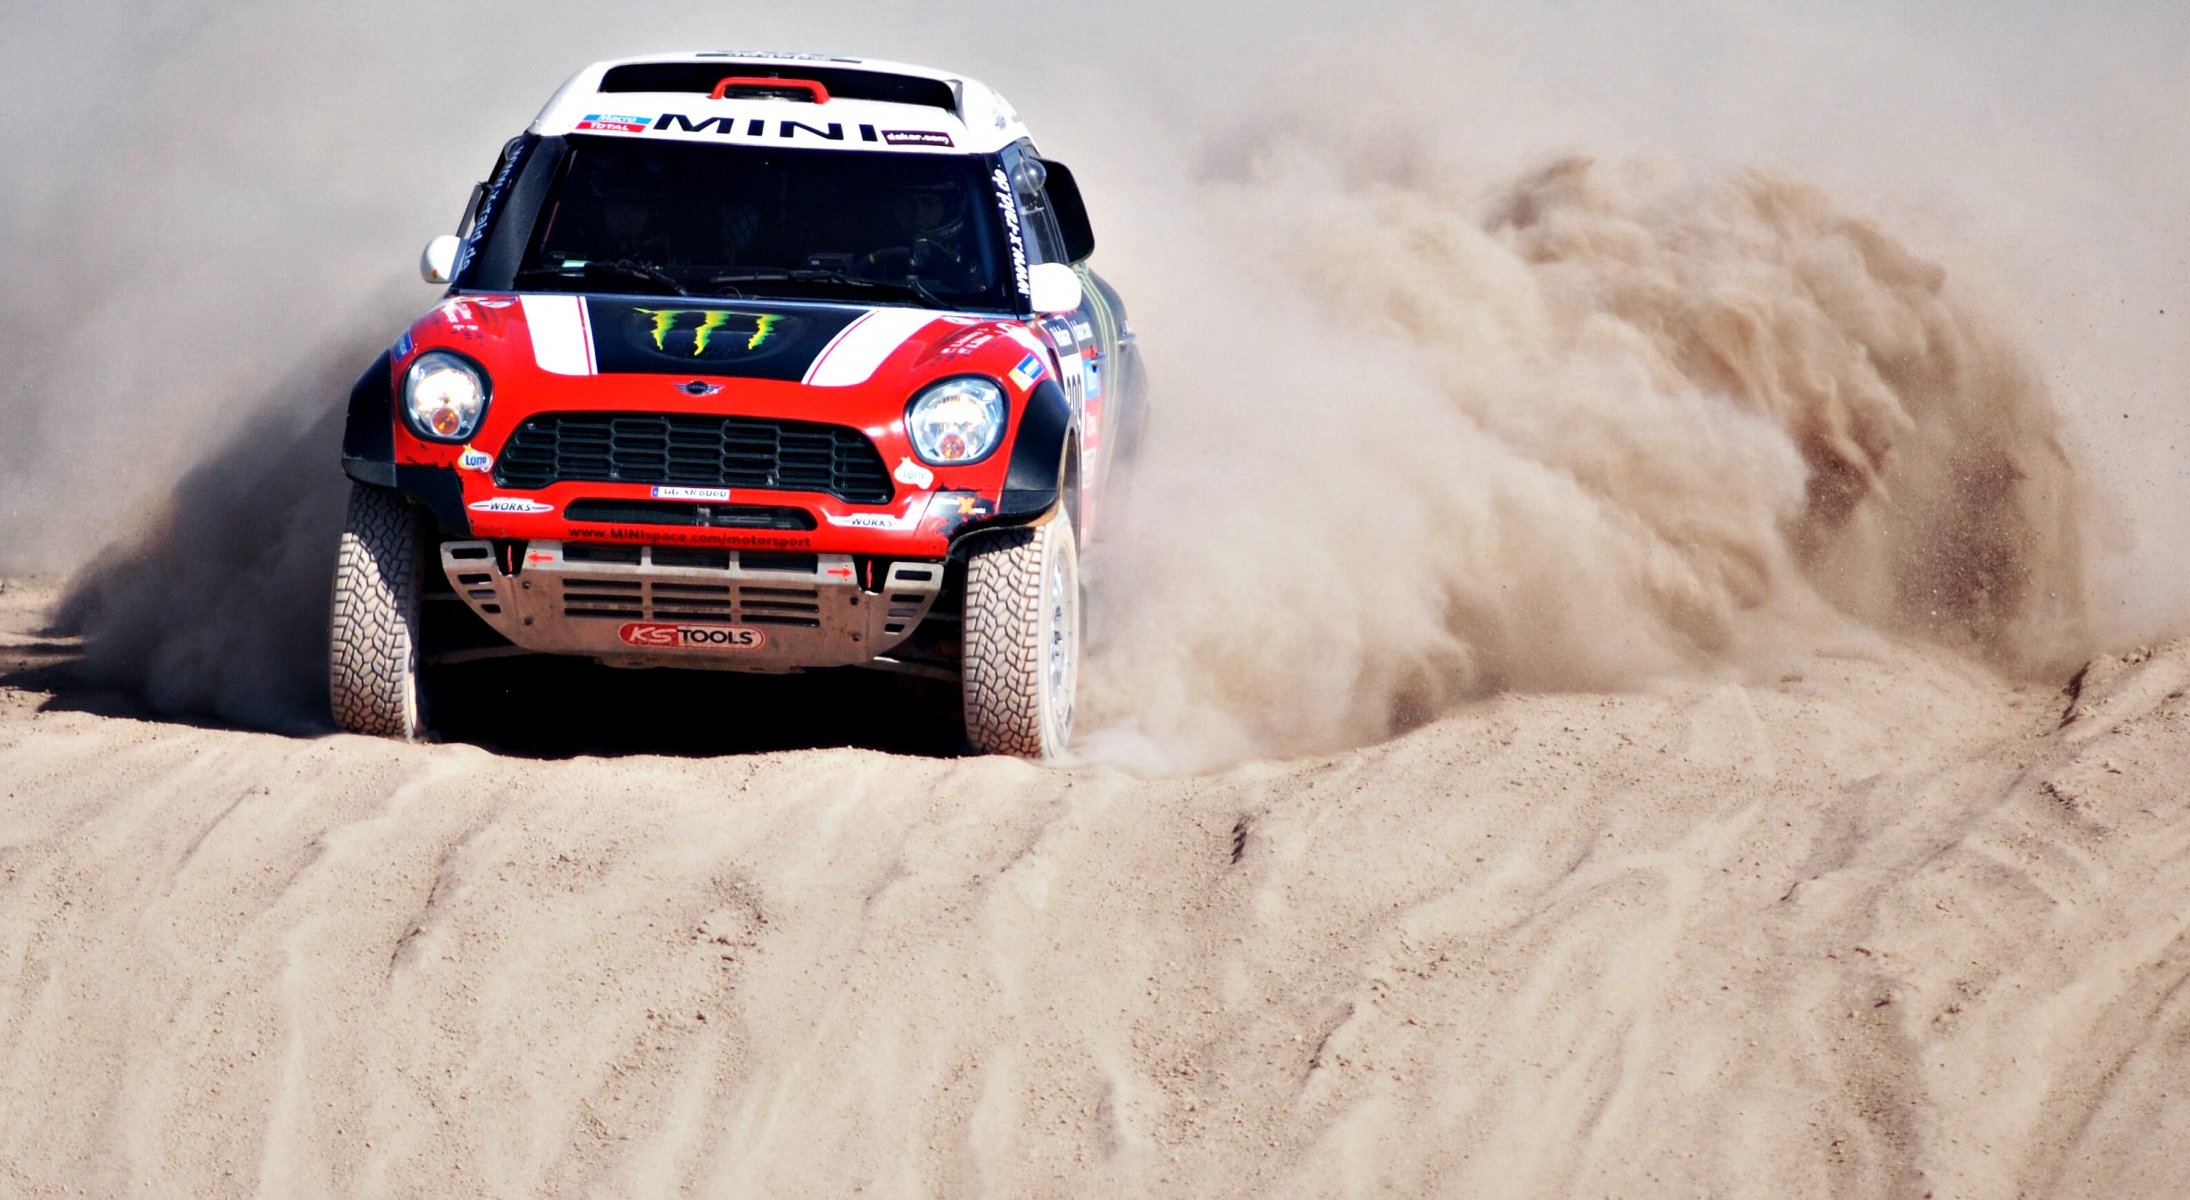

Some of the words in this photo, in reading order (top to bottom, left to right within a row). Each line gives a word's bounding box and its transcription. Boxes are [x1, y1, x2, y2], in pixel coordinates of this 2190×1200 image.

[590, 122, 630, 131] TOTAL
[653, 113, 878, 142] MINI
[886, 132, 950, 145] dakar.com
[991, 167, 1031, 296] www.x-raid.de
[490, 501, 531, 512] WORKS
[851, 517, 894, 528] WORKS
[568, 527, 811, 547] www.MINIspace.com/motorsport
[629, 626, 677, 644] KS
[678, 629, 753, 645] TOOLS
